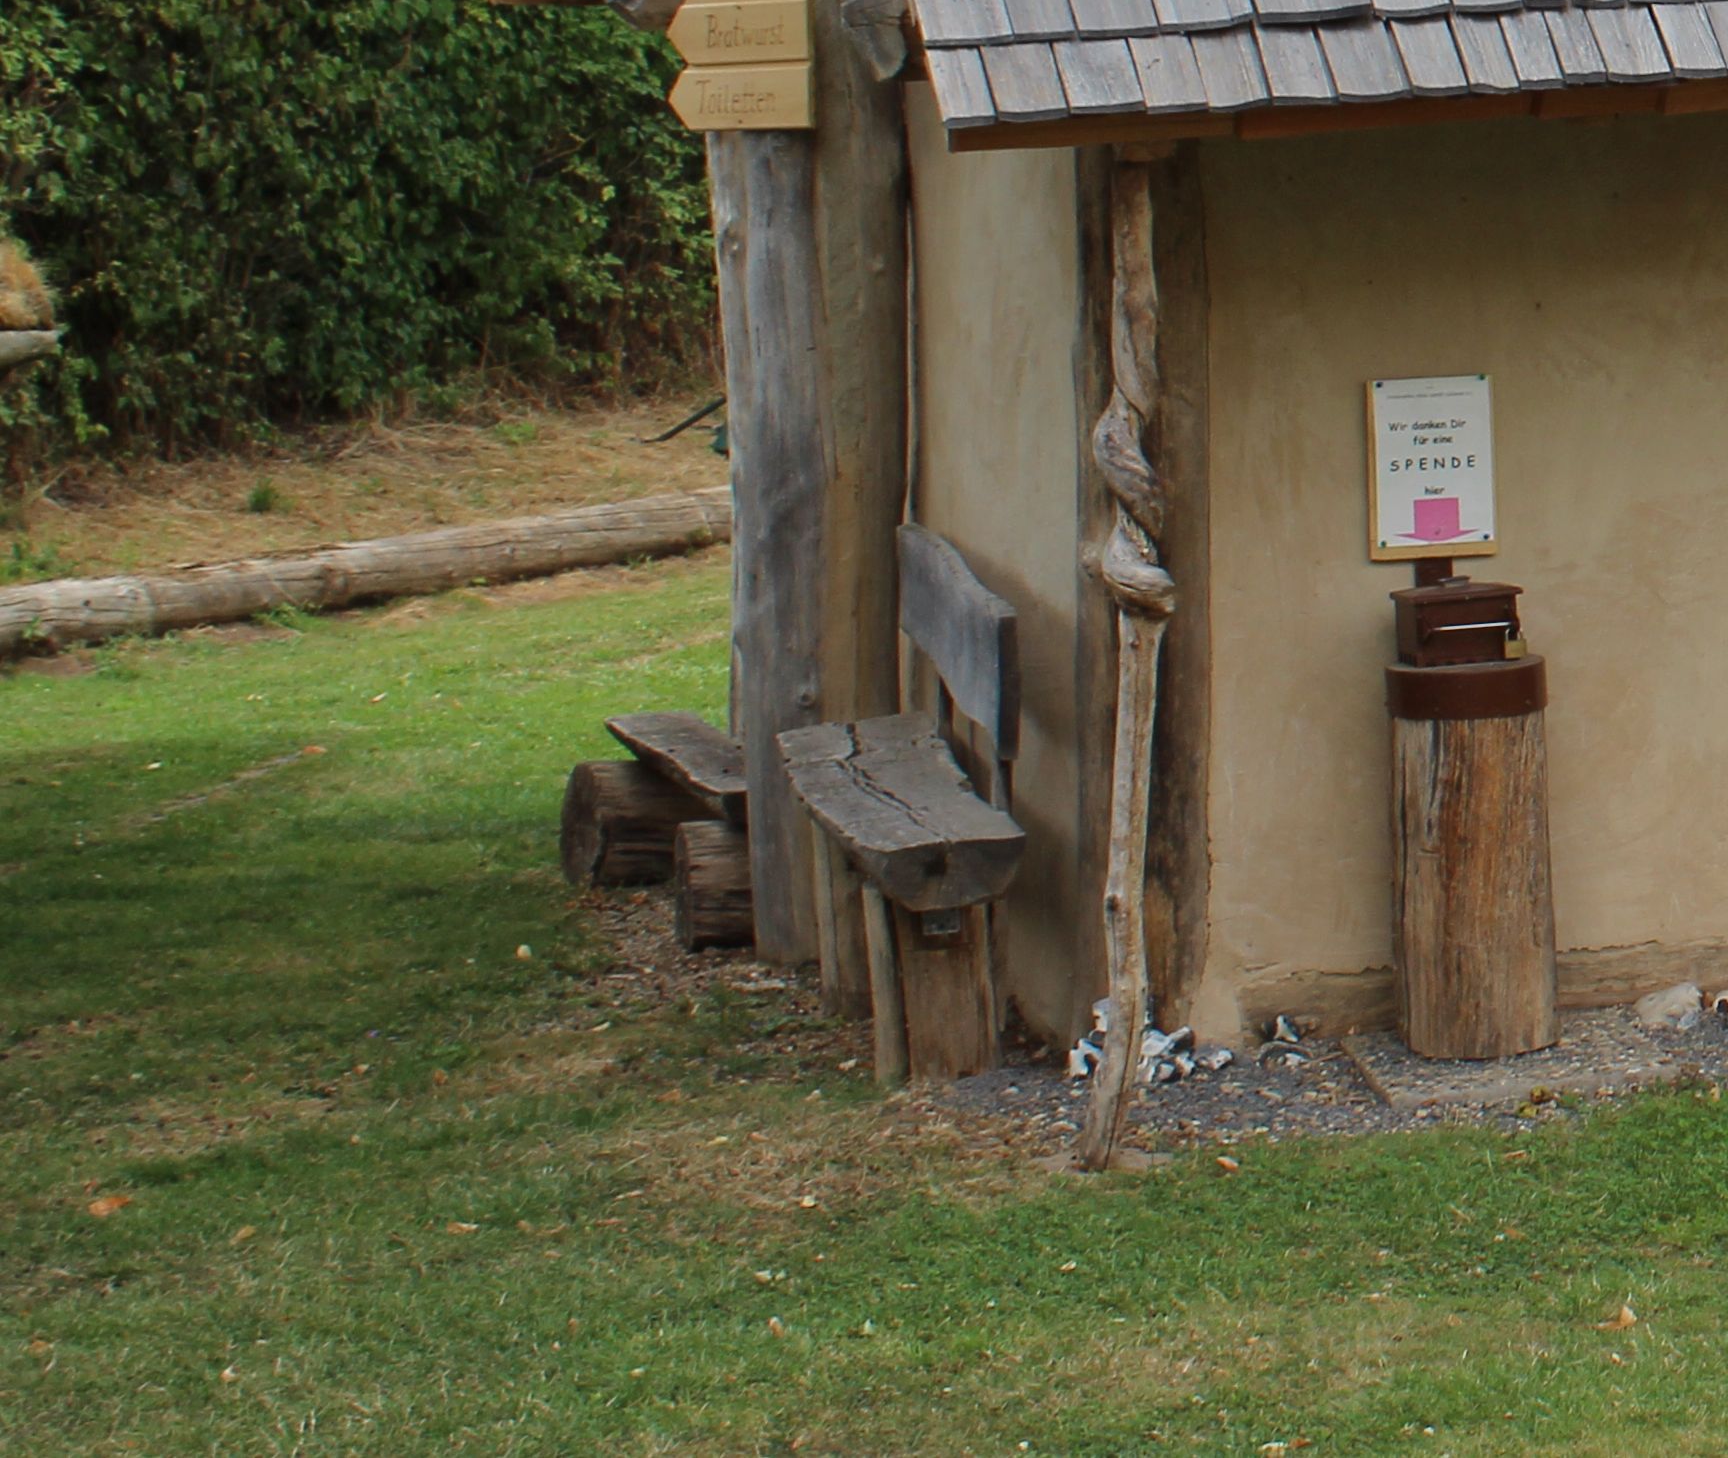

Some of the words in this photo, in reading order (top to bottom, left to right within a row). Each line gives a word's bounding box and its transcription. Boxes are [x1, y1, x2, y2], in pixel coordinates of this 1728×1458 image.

[705, 14, 785, 49] Bratwurst
[695, 79, 777, 115] Toiletten
[1388, 422, 1408, 431] Wir
[1412, 420, 1447, 431] danken
[1450, 419, 1466, 429] Dir
[1413, 435, 1429, 445] für
[1433, 435, 1453, 444] eine
[1424, 485, 1445, 495] hier
